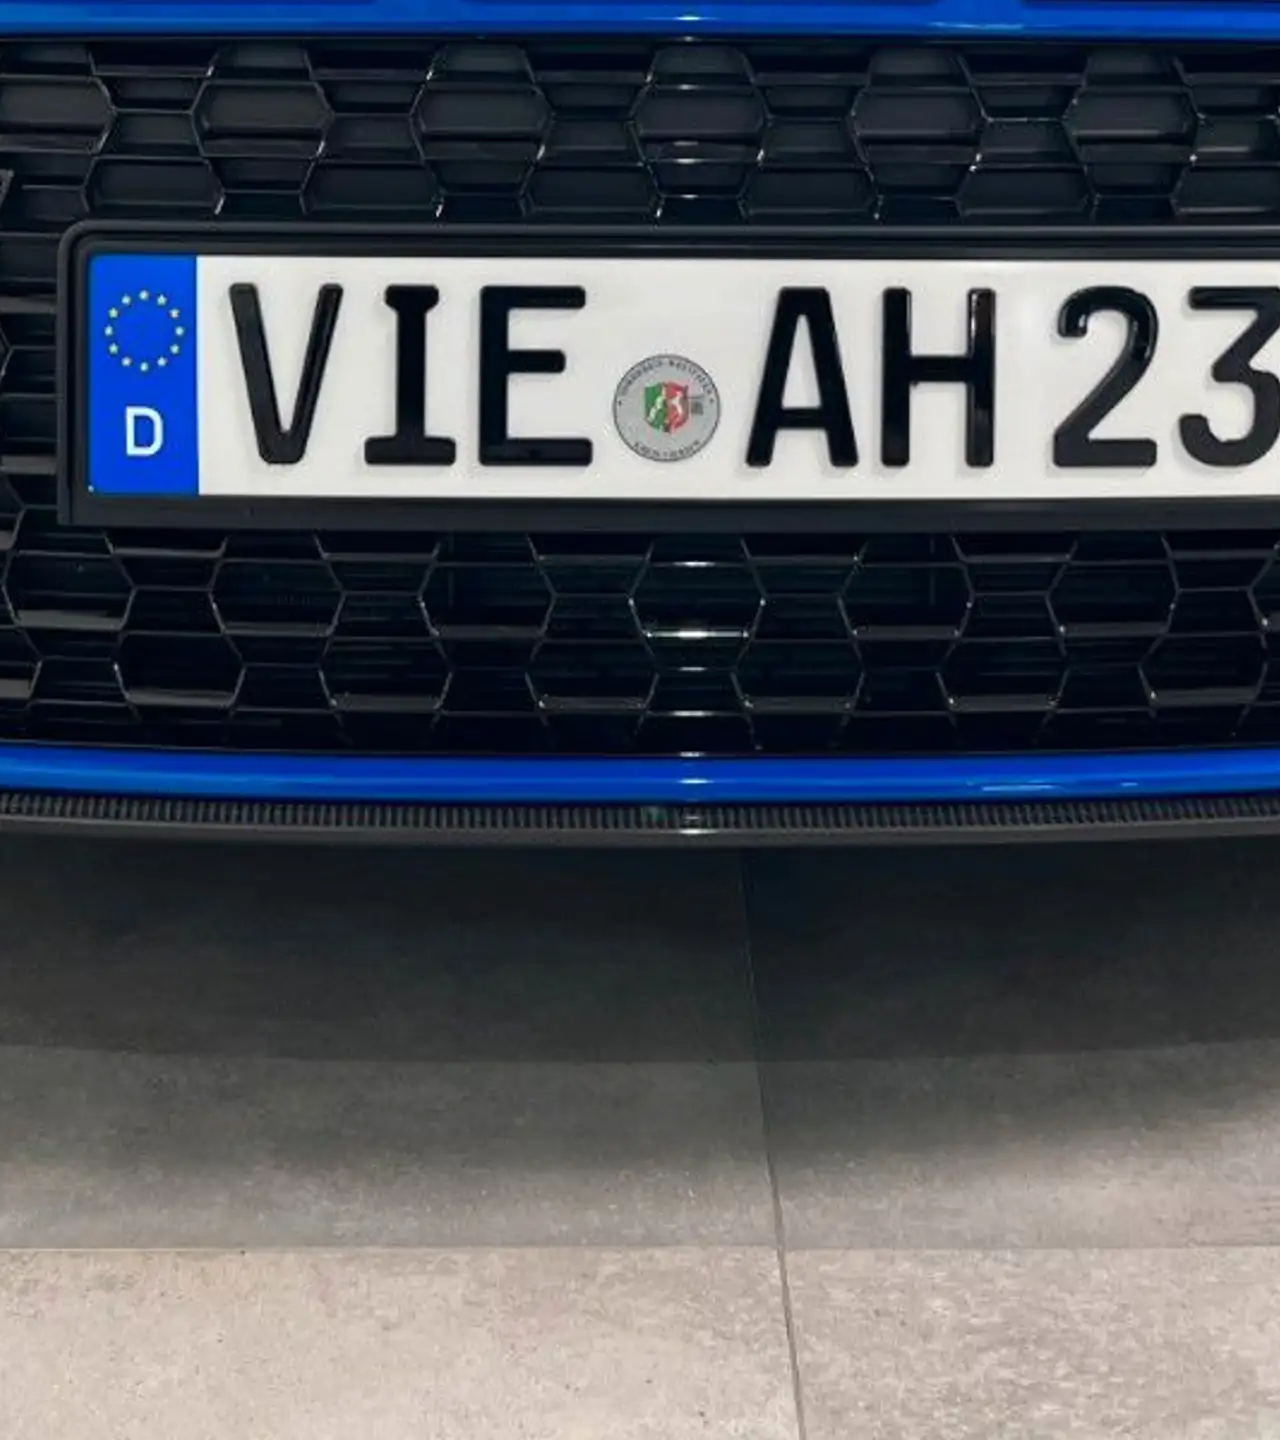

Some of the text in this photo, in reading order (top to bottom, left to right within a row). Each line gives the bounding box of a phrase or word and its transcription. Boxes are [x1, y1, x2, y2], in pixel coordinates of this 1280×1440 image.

[125, 406, 164, 457] D
[229, 283, 593, 465] VIE
[745, 286, 996, 468] AH
